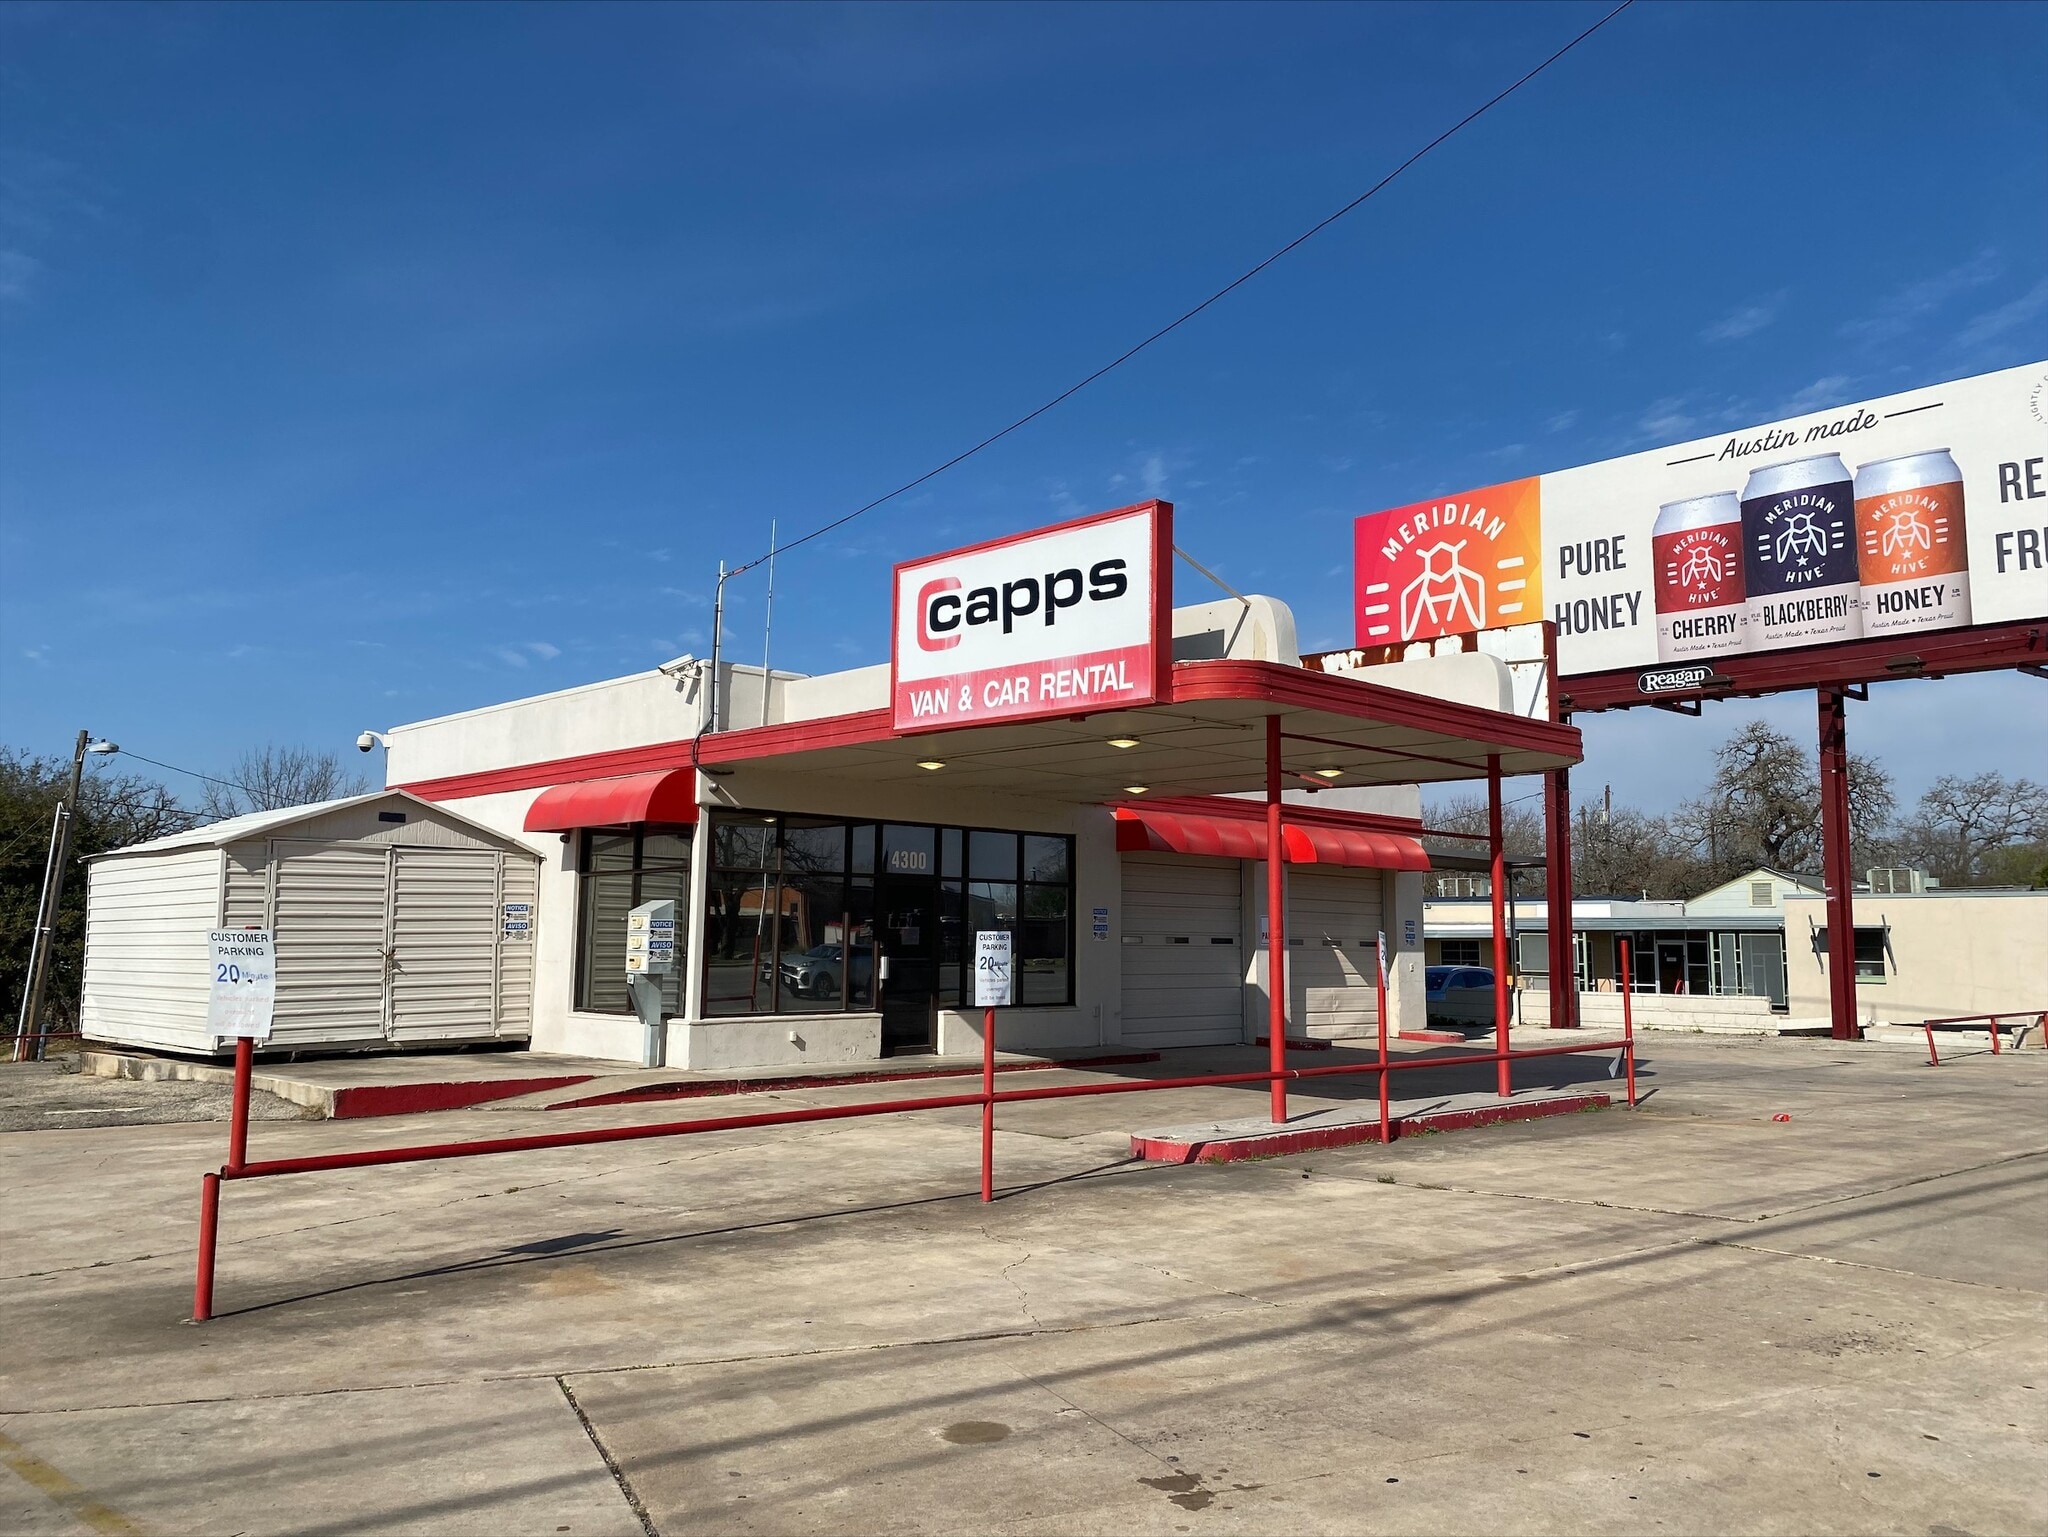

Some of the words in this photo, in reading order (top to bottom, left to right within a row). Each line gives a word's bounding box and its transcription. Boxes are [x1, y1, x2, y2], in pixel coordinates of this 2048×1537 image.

[2030, 383, 2043, 422] LIGHTLY
[1718, 429, 1800, 462] Austin
[1804, 408, 1879, 443] made
[1764, 494, 1836, 525] MERIDIAN
[1871, 494, 1939, 522] MERIDIAN
[1381, 503, 1507, 563] MERIDIAN
[1672, 530, 1729, 555] MERIDIAN
[1559, 534, 1627, 579] PURE
[1995, 526, 2048, 574] FR
[1785, 567, 1823, 583] HIVE
[1891, 559, 1927, 574] HIVE
[1688, 590, 1719, 604] HIVE
[1877, 584, 1945, 615] HONEY
[1555, 590, 1642, 637] HONEY
[1763, 594, 1848, 627] BLACKBERRY
[1672, 613, 1737, 640] CHERRY
[1784, 630, 1803, 638] Made
[909, 688, 949, 718] VAN
[958, 684, 973, 712] &
[983, 676, 1030, 708] CAR
[1039, 660, 1134, 701] RENTAL
[1645, 669, 1705, 691] Reagan
[891, 850, 927, 870] 4300
[211, 932, 269, 943] CUSTOMER
[650, 941, 672, 949] AVISO
[979, 933, 1009, 941] CUSTOMER
[982, 943, 1008, 951] PARKING
[218, 946, 264, 956] PARKING
[217, 963, 240, 983] 20
[980, 956, 994, 970] 20
